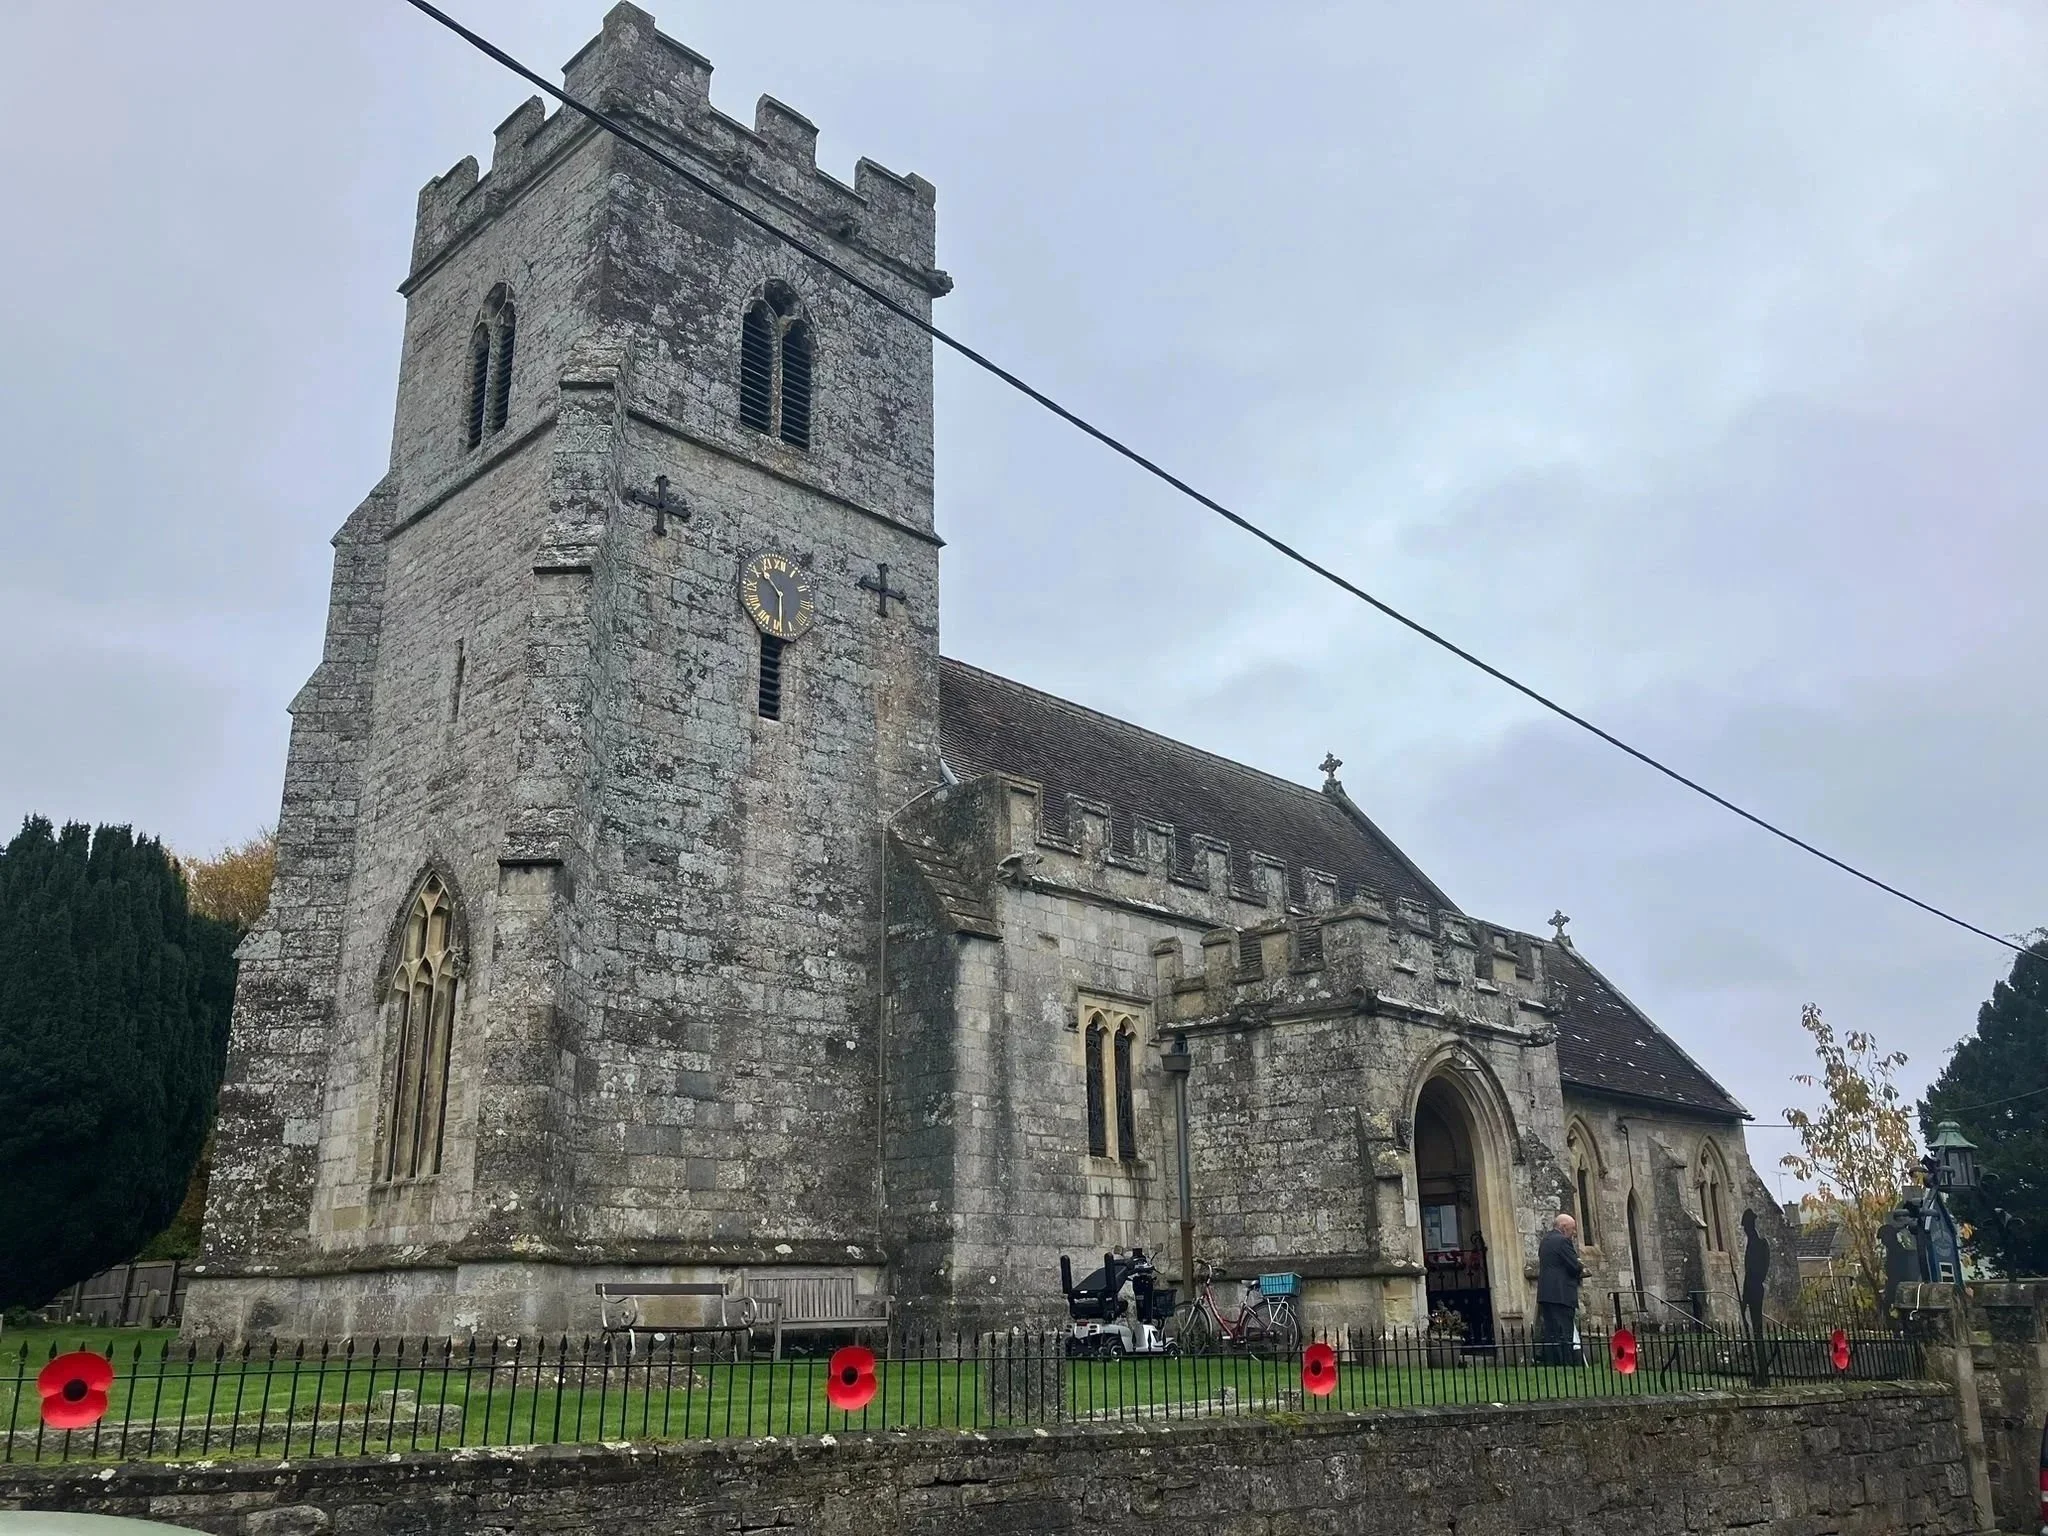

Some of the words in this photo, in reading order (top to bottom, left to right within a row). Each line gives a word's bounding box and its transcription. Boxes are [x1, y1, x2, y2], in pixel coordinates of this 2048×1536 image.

[750, 565, 762, 578] X
[773, 559, 787, 572] XII
[746, 579, 757, 591] IX
[748, 594, 761, 610] VIII
[799, 599, 810, 610] III
[758, 609, 771, 625] VII
